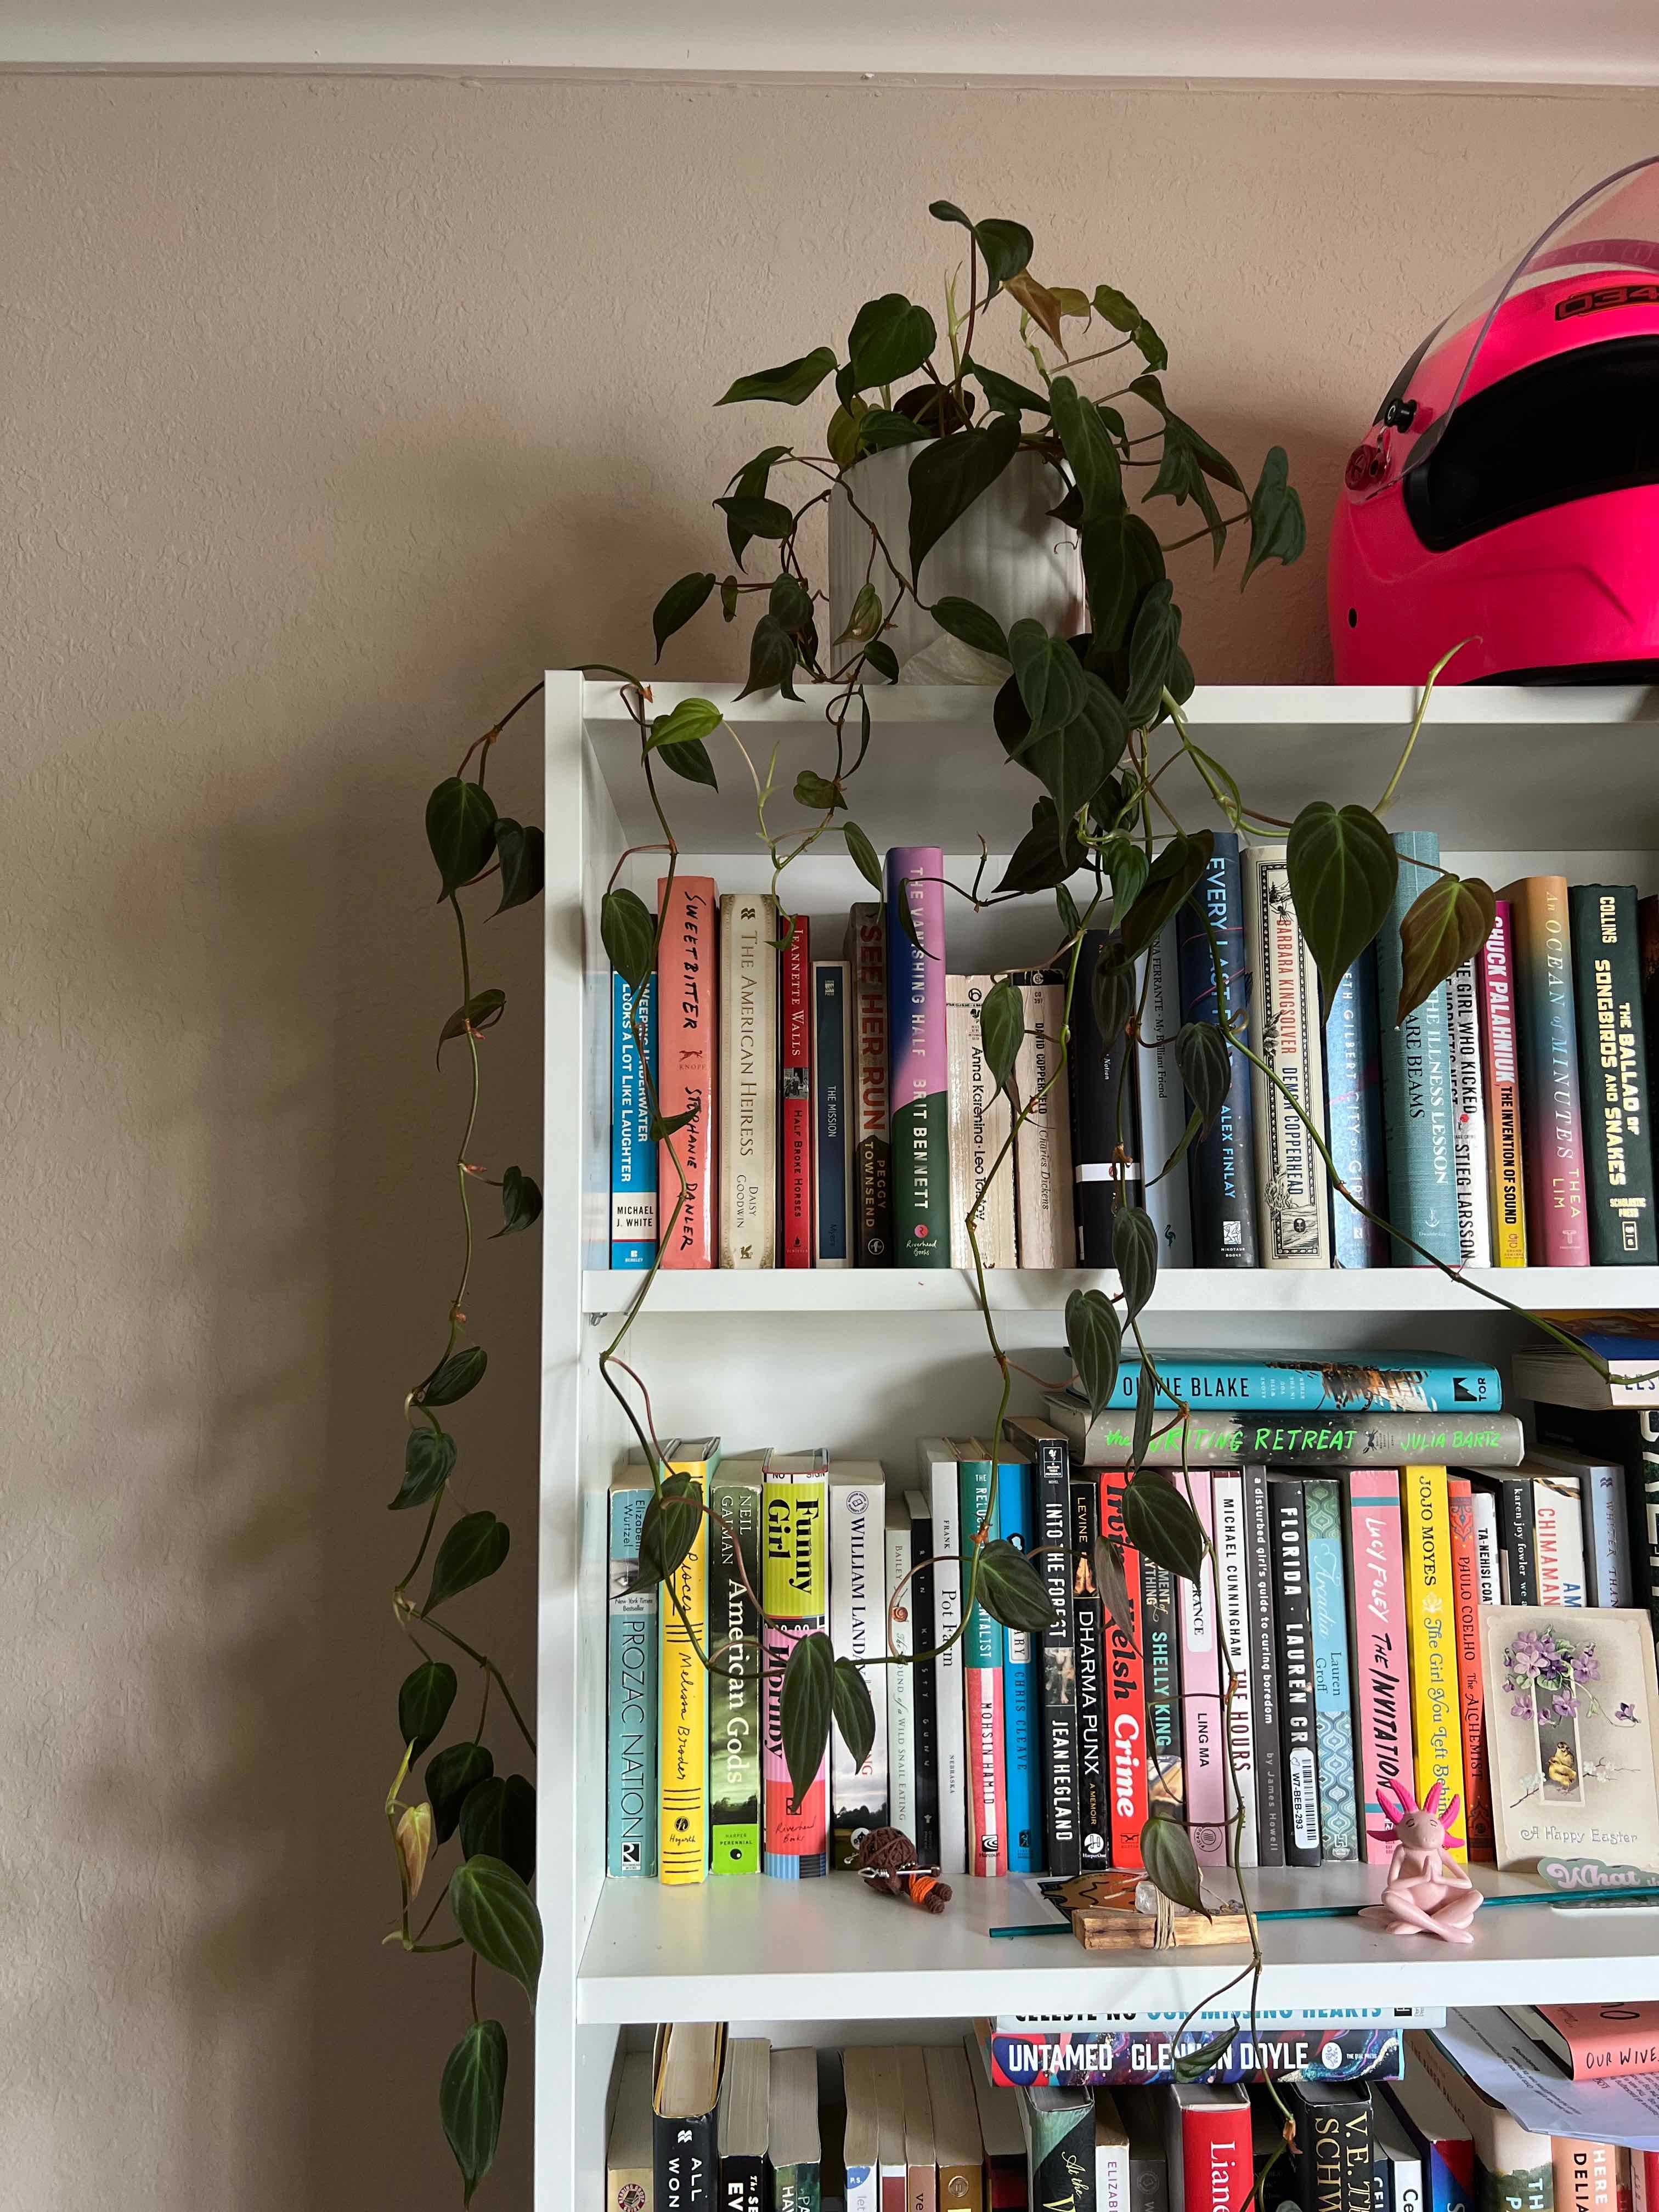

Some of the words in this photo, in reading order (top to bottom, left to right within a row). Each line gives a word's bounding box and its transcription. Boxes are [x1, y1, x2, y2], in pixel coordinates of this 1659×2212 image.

[1206, 857, 1227, 929] EVERY
[1600, 896, 1617, 943] COLLINS
[682, 892, 706, 1029] SWEETBITTER
[741, 930, 758, 968] THE
[861, 925, 884, 983] SEE
[1277, 920, 1292, 974] BARBARA
[1545, 919, 1566, 1008] OCEAN
[1153, 957, 1164, 1012] FERRANTE
[1457, 983, 1471, 1018] GIRL
[741, 975, 758, 1075] AMERICAN
[792, 1010, 803, 1056] WALLS
[862, 995, 883, 1060] HER
[1155, 1019, 1164, 1036] My
[1489, 981, 1515, 1084] PALAHNIUK
[1594, 959, 1616, 1068] SONGBIRDS
[1620, 1003, 1631, 1028] THE
[623, 1044, 633, 1071] LOT
[912, 1015, 925, 1057] HALF
[1460, 1022, 1474, 1056] WHO
[972, 1047, 985, 1081] Anna
[1103, 1058, 1111, 1080] Notion
[1157, 1071, 1167, 1098] Friend
[1426, 1029, 1444, 1108] ILLNESS
[1620, 1034, 1639, 1111] BALLAD
[623, 1076, 633, 1106] LIKE
[827, 1086, 836, 1102] THE
[864, 1068, 884, 1130] RUN
[913, 1079, 928, 1118] BRIT
[1460, 1060, 1477, 1114] KICKED
[1501, 1086, 1514, 1107] THE
[1551, 1036, 1575, 1160] MINUTES
[1605, 1074, 1618, 1101] AND
[740, 1081, 758, 1156] HEIRESS
[793, 1110, 802, 1136] HALF
[827, 1104, 836, 1137] MISSION
[1221, 1105, 1233, 1142] ALEX
[1502, 1109, 1515, 1166] INVENTION
[1627, 1116, 1639, 1135] OF
[622, 1111, 633, 1182] LAUGHTER
[793, 1141, 803, 1175] BROKE
[913, 1127, 928, 1209] BENNETT
[974, 1151, 986, 1175] Leo
[1039, 1130, 1048, 1167] Charles
[1283, 1115, 1304, 1195] COPPERHEAD
[1431, 1112, 1448, 1184] LESSON
[1455, 1144, 1472, 1186] STIEG
[1605, 1107, 1626, 1186] SNAKES
[864, 1142, 876, 1227] TOWNSEND
[877, 1160, 885, 1209] PEGGY
[1040, 1171, 1051, 1210] Dickens
[1223, 1148, 1235, 1198] FINLAY
[1503, 1169, 1515, 1183] OF
[1553, 1177, 1565, 1209] LIM
[1568, 1168, 1581, 1218] THEA
[736, 1175, 747, 1228] GOODWIN
[748, 1187, 758, 1216] DAISY
[794, 1179, 803, 1217] HORSES
[1504, 1186, 1517, 1224] SOUND
[906, 1239, 938, 1249] Riverhead
[1458, 1192, 1476, 1259] LARSSON
[1191, 1377, 1250, 1397] BLAKE
[1254, 1430, 1358, 1451] RETREAT
[1400, 1433, 1447, 1451] JULIA
[1452, 1430, 1500, 1448] BARTZ
[739, 1495, 752, 1535] NEIL
[1077, 1497, 1088, 1543] LEVINE
[1255, 1488, 1265, 1544] disturbed
[1419, 1476, 1431, 1521] JOJO
[1514, 1488, 1525, 1518] karen
[623, 1504, 633, 1547] Wurtzel
[767, 1499, 791, 1560] Girl
[789, 1498, 820, 1595] Funny
[1223, 1498, 1237, 1559] MICHAEL
[1365, 1517, 1386, 1560] LUCY
[1514, 1521, 1526, 1539] joy
[851, 1517, 865, 1600] WILLIAM
[895, 1545, 903, 1580] BAILEY
[1280, 1508, 1301, 1596] FLORIDA
[1422, 1525, 1436, 1586] MOYES
[1478, 1528, 1492, 1579] TA-NEHISI
[1517, 1543, 1528, 1575] fowler
[1257, 1581, 1268, 1611] guide
[1367, 1563, 1389, 1622] FOLEY
[1459, 1556, 1473, 1601] PAULO
[1225, 1565, 1242, 1657] CUNNINGHAM
[1261, 1616, 1269, 1628] to
[1259, 1633, 1270, 1669] curing
[1425, 1618, 1442, 1648] The
[1462, 1605, 1476, 1661] COELHO
[622, 1621, 645, 1724] PROZAC
[1078, 1611, 1094, 1708] DHARMA
[1152, 1632, 1169, 1695] SHELLY
[1285, 1623, 1306, 1703] LAUREN
[1316, 1658, 1328, 1692] Groff
[1331, 1651, 1342, 1696] Lauren
[1430, 1652, 1445, 1683] Girl
[678, 1652, 692, 1720] Melissa
[1014, 1672, 1026, 1713] CHRIS
[1262, 1674, 1272, 1724] boredom
[1466, 1674, 1477, 1690] The
[1155, 1703, 1172, 1746] KING
[1197, 1713, 1208, 1744] LING
[1427, 1688, 1447, 1726] You
[897, 1718, 906, 1744] WILD
[982, 1703, 994, 1755] MOHSIN
[1016, 1720, 1028, 1770] CLEAVE
[1052, 1720, 1070, 1759] JEAN
[1082, 1714, 1100, 1775] PUNX
[1431, 1729, 1448, 1759] Left
[1465, 1694, 1483, 1780] ALCHEMIST
[675, 1726, 690, 1780] Broder
[898, 1749, 906, 1778] SNAIL
[1115, 1713, 1138, 1817] Crime
[1199, 1747, 1210, 1767] MA
[1265, 1752, 1273, 1764] by
[621, 1734, 645, 1838] NATION
[899, 1782, 908, 1821] EATING
[983, 1763, 995, 1804] HAMID
[1054, 1764, 1073, 1840] HEGLAND
[1267, 1771, 1276, 1809] James
[1292, 1772, 1303, 1830] W7-BEB-293
[1089, 1790, 1098, 1825] MEMOIR
[1269, 1813, 1278, 1851] Howell
[1520, 1826, 1538, 1840] A
[1545, 1826, 1585, 1843] Happy
[1592, 1830, 1637, 1844] Easter
[1547, 1863, 1640, 1888] What
[1008, 2044, 1113, 2072] UNTAMED
[1587, 2052, 1611, 2069] OUR
[690, 2157, 703, 2202] ALL
